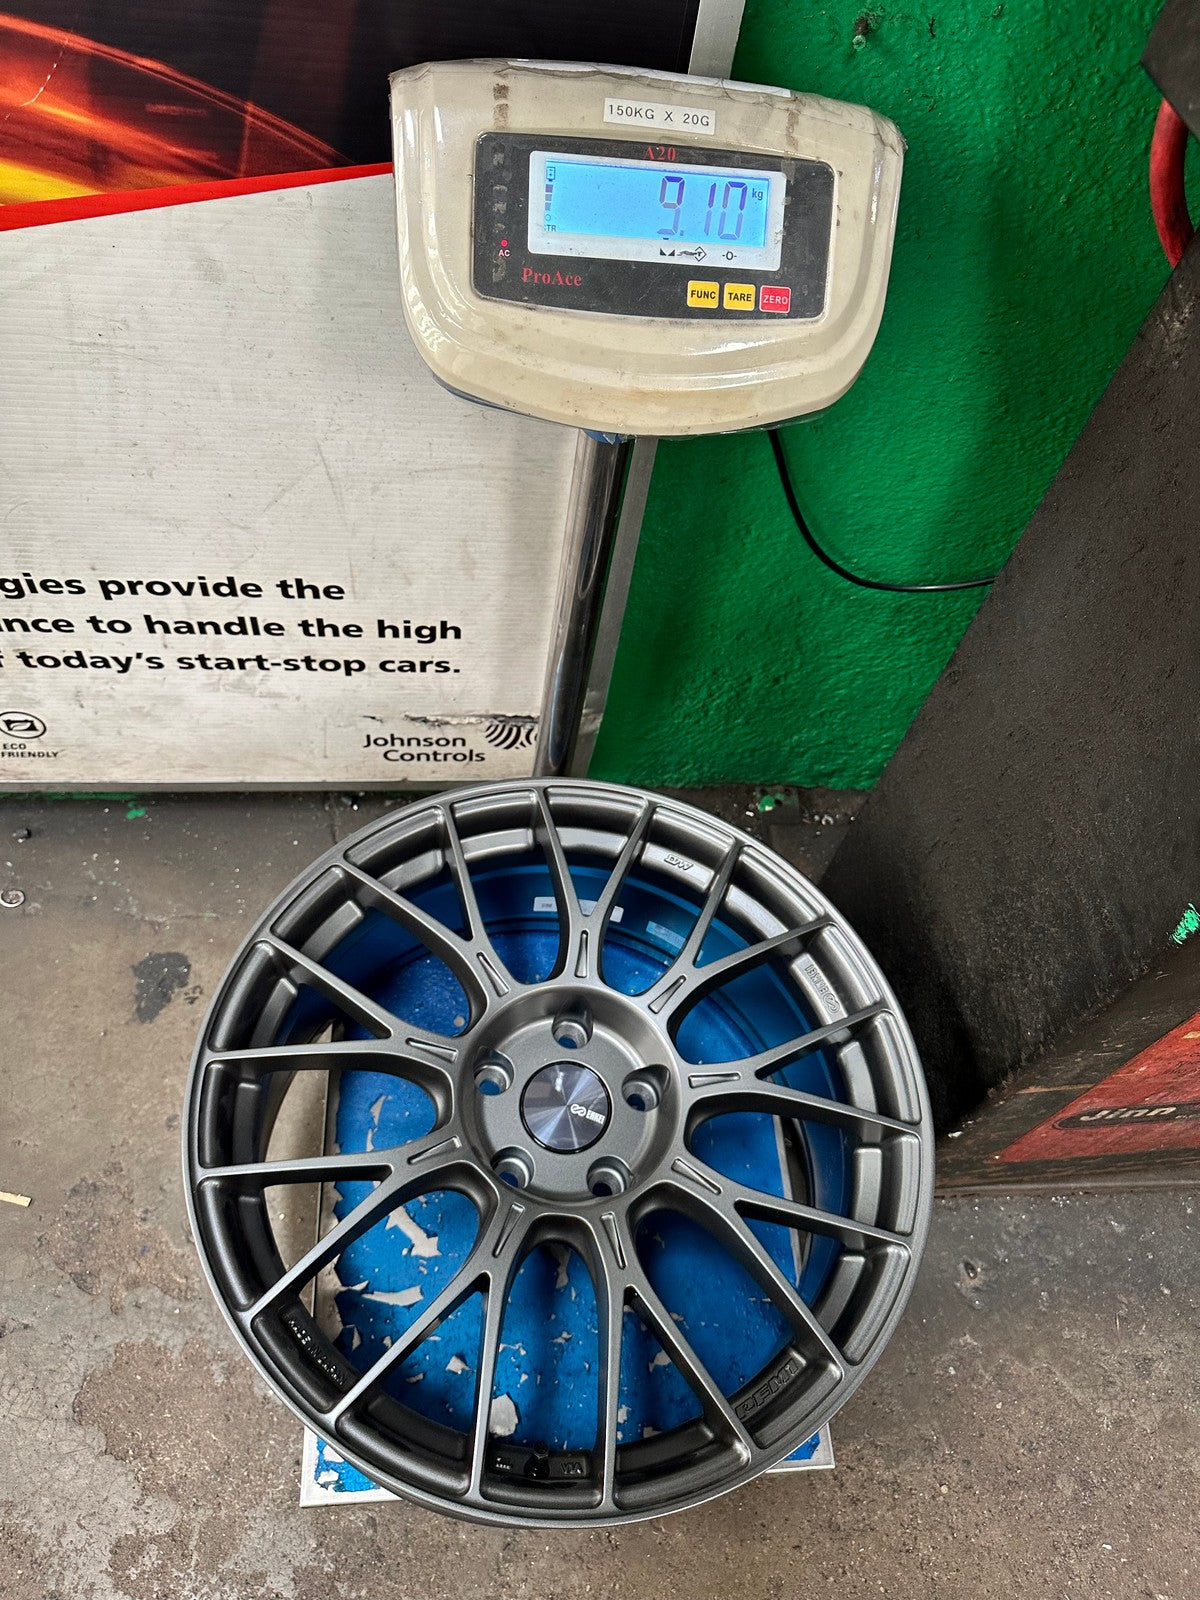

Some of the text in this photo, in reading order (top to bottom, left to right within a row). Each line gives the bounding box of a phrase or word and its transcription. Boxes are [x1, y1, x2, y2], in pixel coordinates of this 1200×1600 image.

[608, 104, 710, 127] 150KG X 20G
[643, 145, 677, 161] A20
[656, 175, 764, 240] 9.10 kg
[498, 249, 511, 257] AC
[521, 266, 583, 287] ProAce
[690, 289, 716, 300] FUNC
[728, 292, 752, 302] TARE
[763, 294, 788, 305] ZERO
[98, 575, 263, 601] provide
[276, 578, 345, 600] the
[0, 614, 462, 644] nce to handle the high
[16, 650, 165, 674] today's
[176, 653, 366, 677] start-stop
[378, 659, 461, 674] cars.
[363, 733, 466, 748] Johnson
[383, 749, 485, 762] Controls
